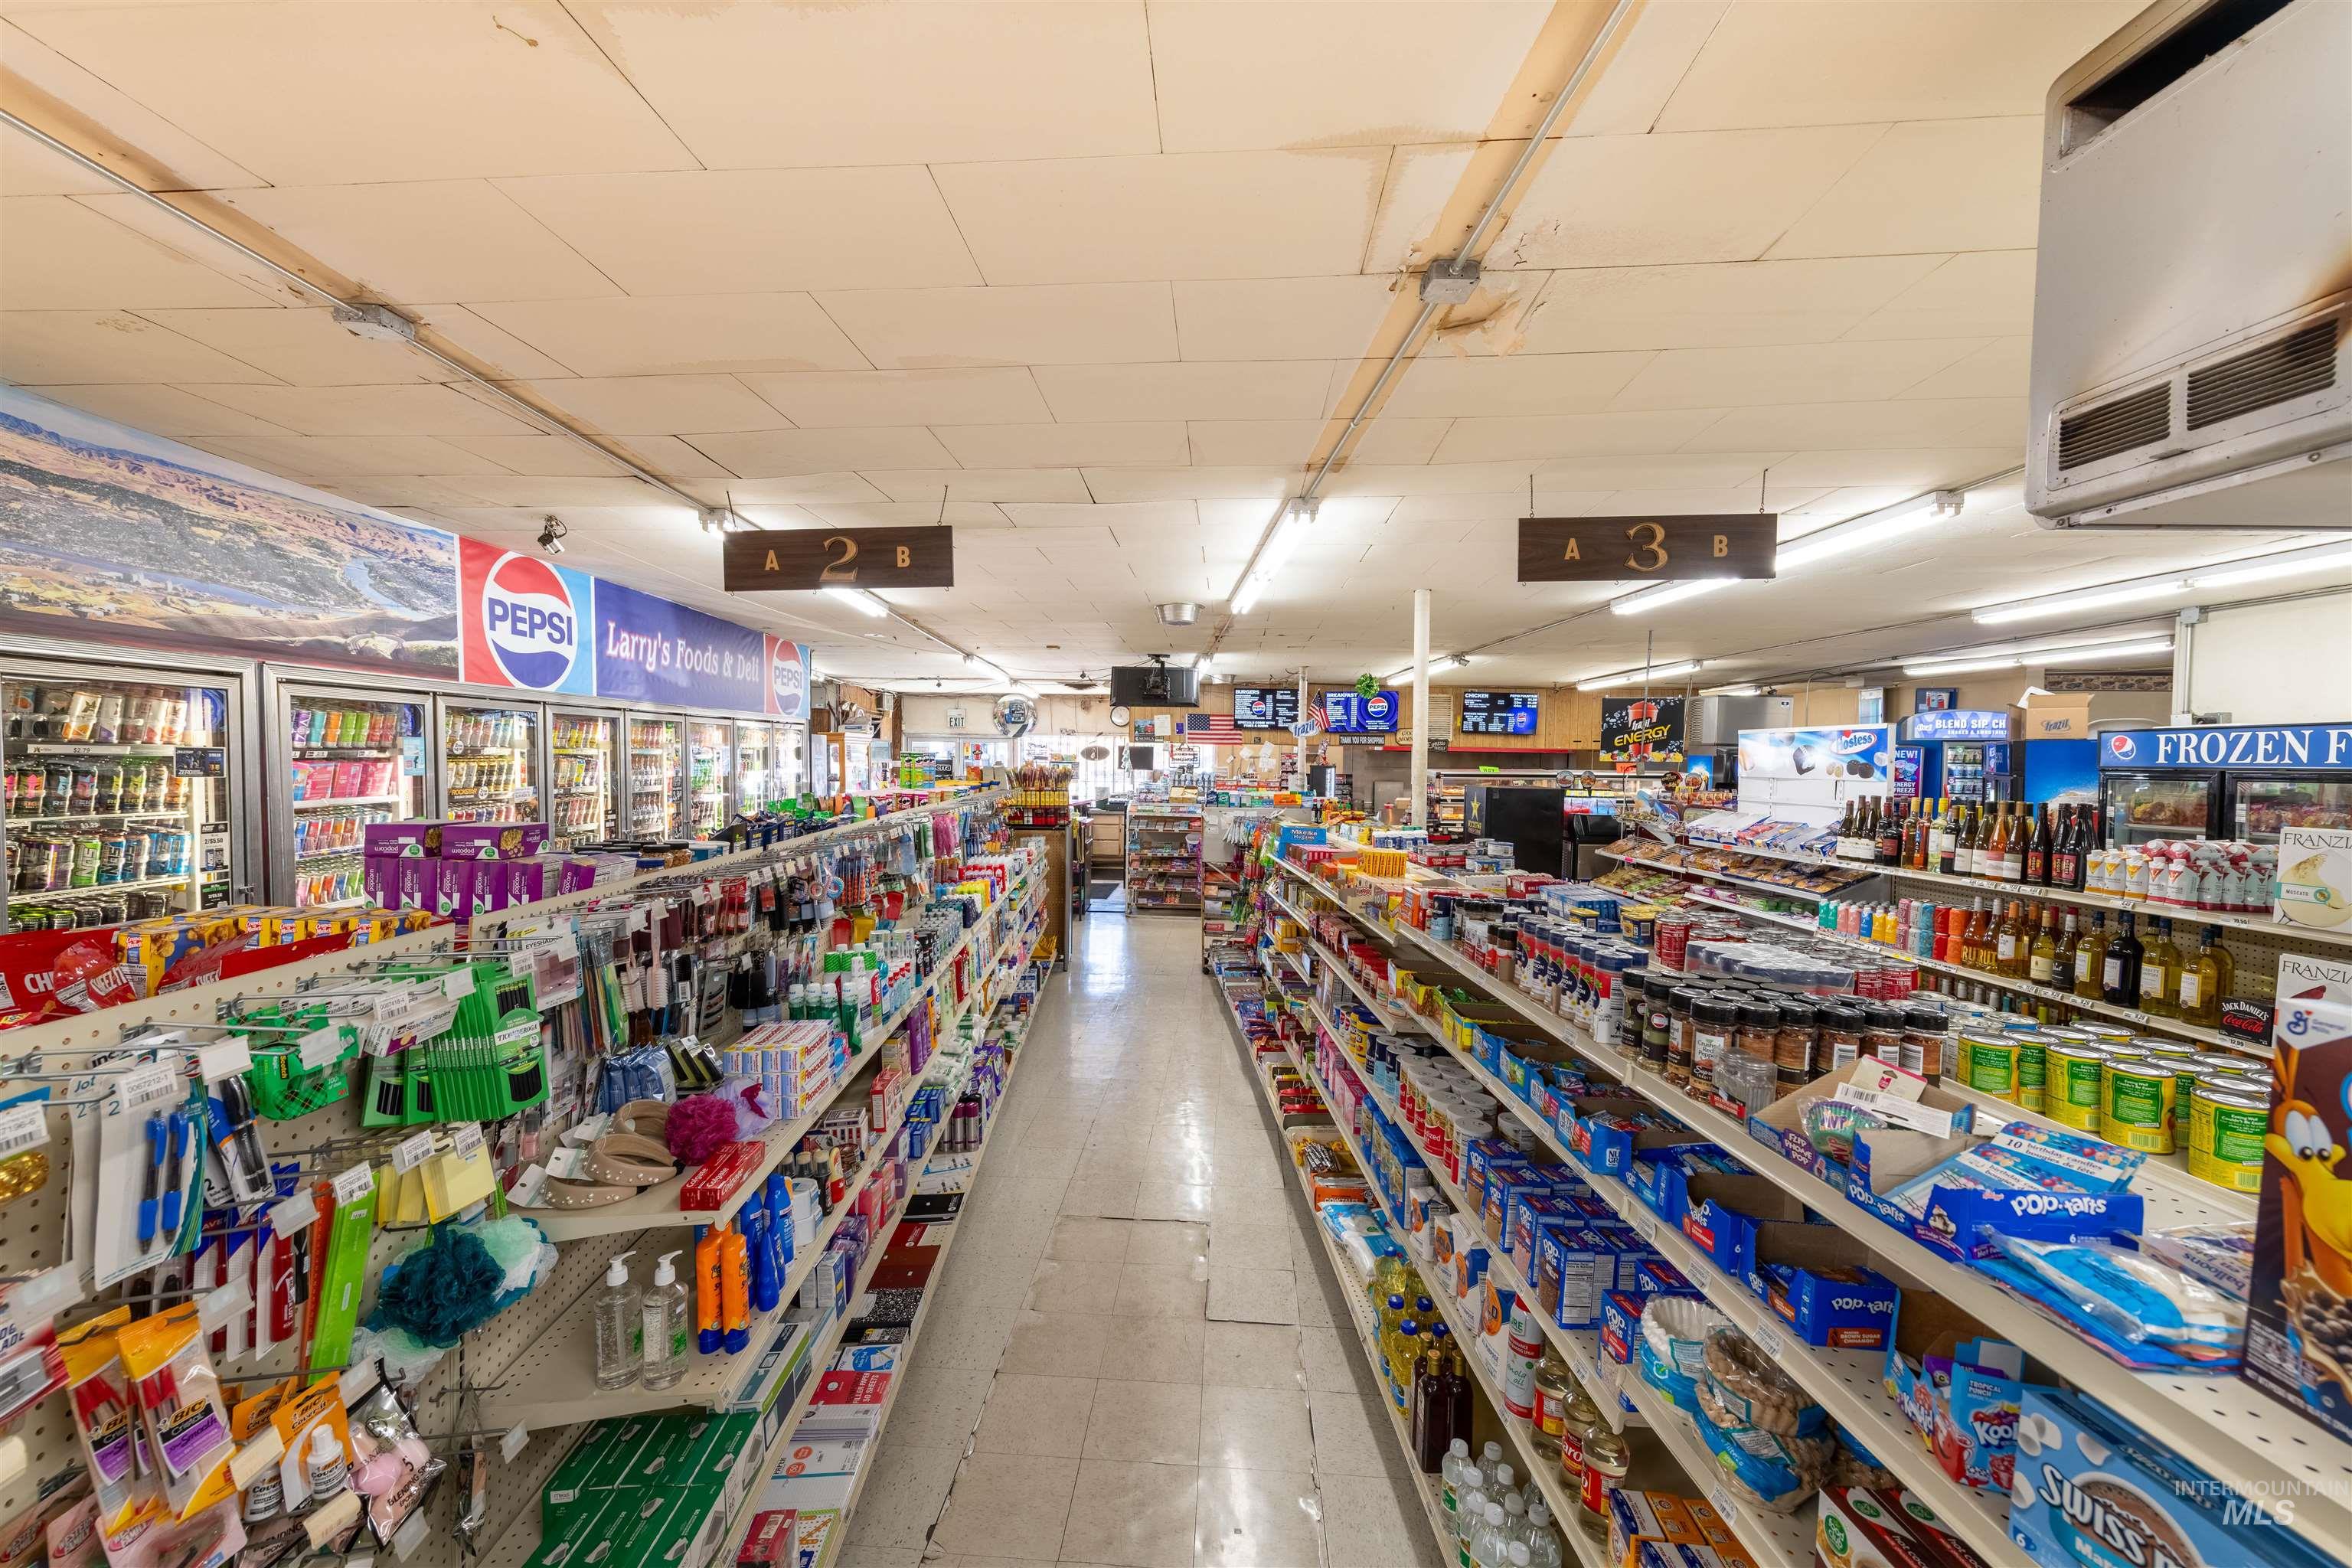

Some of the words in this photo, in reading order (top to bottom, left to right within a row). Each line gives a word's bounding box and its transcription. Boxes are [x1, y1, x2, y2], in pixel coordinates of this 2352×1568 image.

[1564, 538, 1581, 560] A
[1624, 522, 1668, 572] 3
[1713, 535, 1728, 557] B
[765, 550, 779, 571] A
[819, 537, 858, 583] 2
[897, 547, 910, 568] B
[488, 597, 573, 646] PEPSI
[607, 620, 670, 674] Larry's
[676, 635, 719, 676] Foods
[722, 654, 734, 675] &
[736, 654, 760, 684] Deli
[773, 664, 803, 688] PEPSI
[949, 717, 965, 728] EXIT
[1294, 720, 1315, 737] frazil
[1936, 720, 1967, 730] BLEND
[1971, 719, 1988, 729] SIP
[1341, 736, 1351, 744] THANK
[1614, 724, 1671, 746] ENERGY
[1895, 750, 1918, 759] NEW!
[2157, 728, 2321, 766] FROZEN
[564, 870, 573, 894] popcorn
[2285, 888, 2310, 897] MOSCATO
[2222, 1001, 2239, 1012] JACK
[2240, 1001, 2269, 1021] DANIEL'S
[805, 1031, 828, 1058] Pepsodent
[2230, 1038, 2244, 1047] 12.99
[805, 1055, 829, 1082] Pepsodent
[74, 1076, 96, 1093] Jot
[805, 1077, 829, 1104] Pepsodent
[77, 1102, 87, 1119] 2
[108, 1100, 120, 1116] 2
[1784, 1139, 1813, 1161] PHONE
[1788, 1132, 1806, 1148] FLIP
[1792, 1150, 1810, 1166] POP
[2006, 1138, 2024, 1150] 10
[2026, 1142, 2064, 1161] birthday
[2066, 1155, 2104, 1171] candles
[2025, 1148, 2057, 1165] bougies
[2058, 1160, 2074, 1169] de
[204, 1179, 214, 1191] 2
[686, 1168, 707, 1188] Colgate
[707, 1168, 729, 1189] Colgate
[1734, 1244, 1742, 1253] 6
[2069, 1234, 2076, 1243] 6
[2183, 1252, 2246, 1291] balloons
[1968, 1387, 1992, 1397] PUNCH
[1969, 1380, 2001, 1394] TROPICAL
[172, 1398, 204, 1425] BIC
[402, 1457, 415, 1473] 5
[2037, 1462, 2147, 1563] SWISS
[1892, 1534, 1913, 1553] hot
[1947, 1537, 1967, 1557] hot
[2016, 1534, 2026, 1545] 6
